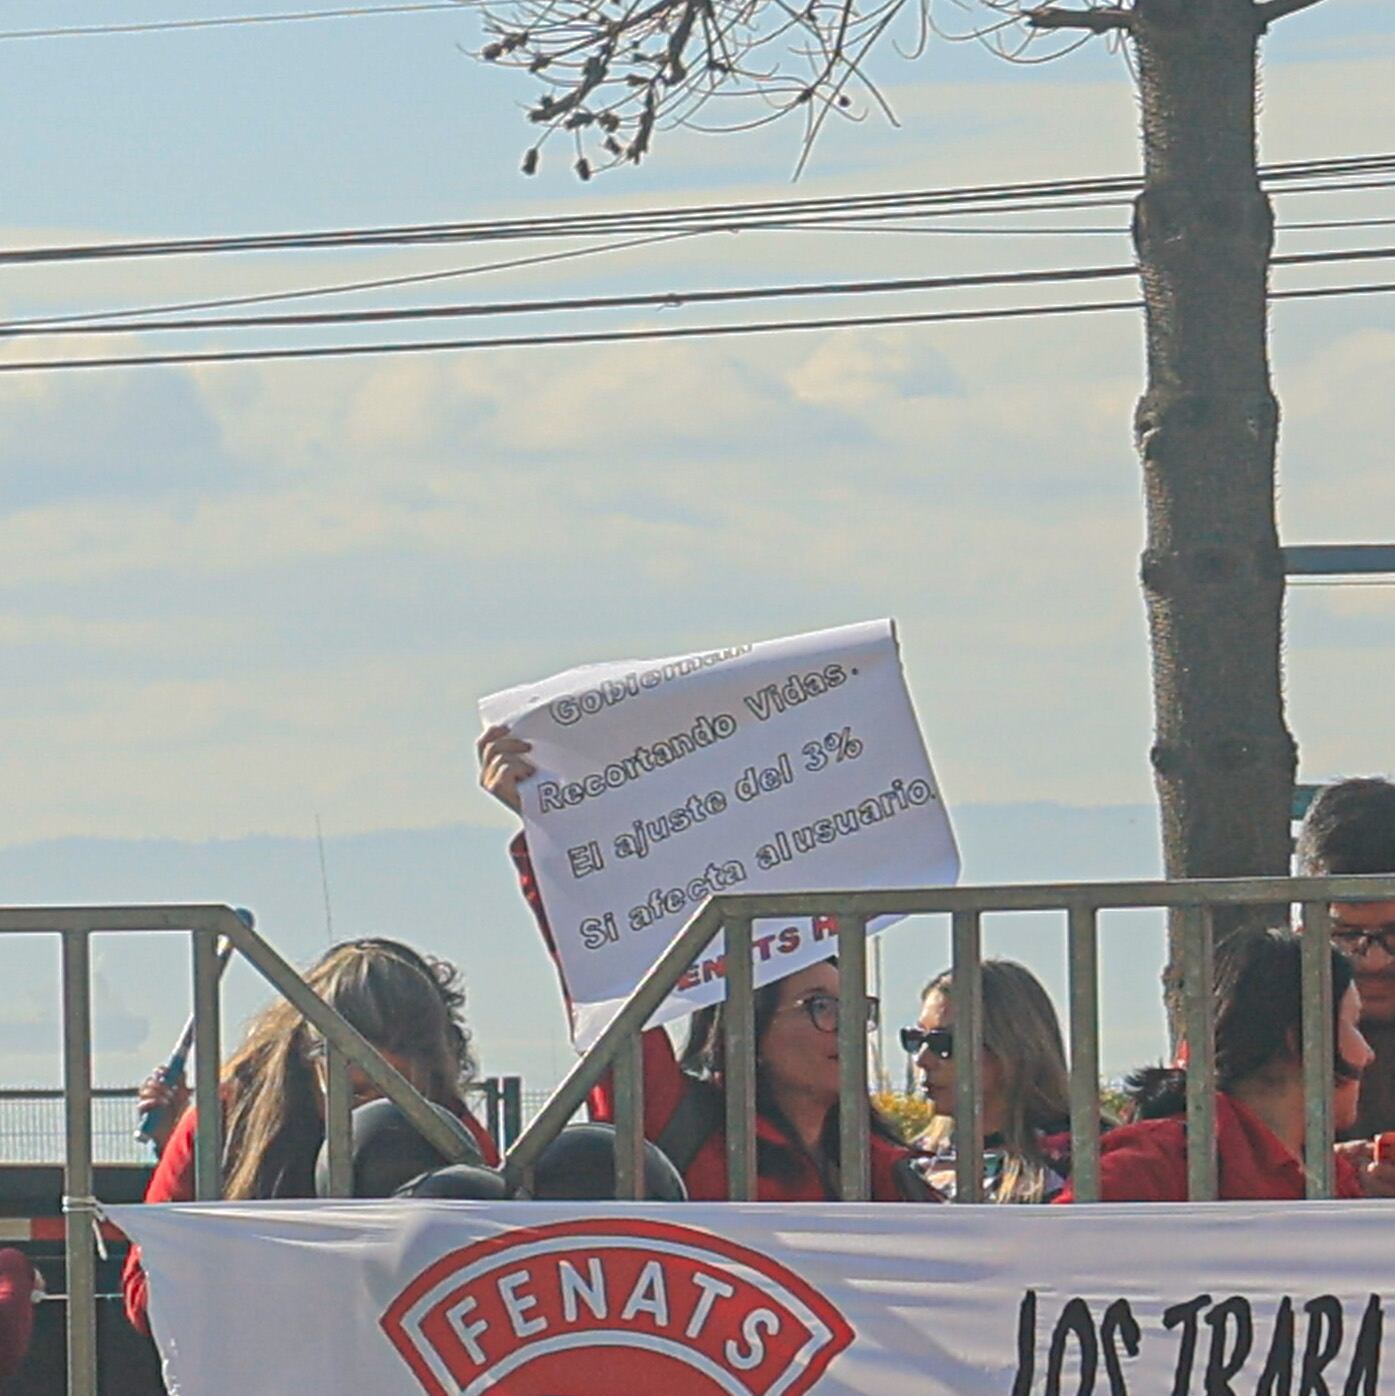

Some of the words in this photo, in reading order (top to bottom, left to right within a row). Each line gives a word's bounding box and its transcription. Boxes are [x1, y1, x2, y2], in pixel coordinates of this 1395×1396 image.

[537, 713, 736, 814] Recortando
[567, 841, 604, 879] El
[614, 791, 727, 858] ajuste
[735, 753, 793, 801] del
[801, 726, 863, 772] 3%
[580, 911, 619, 950] Si
[628, 860, 746, 931] afecta
[445, 1257, 780, 1370] FENATS
